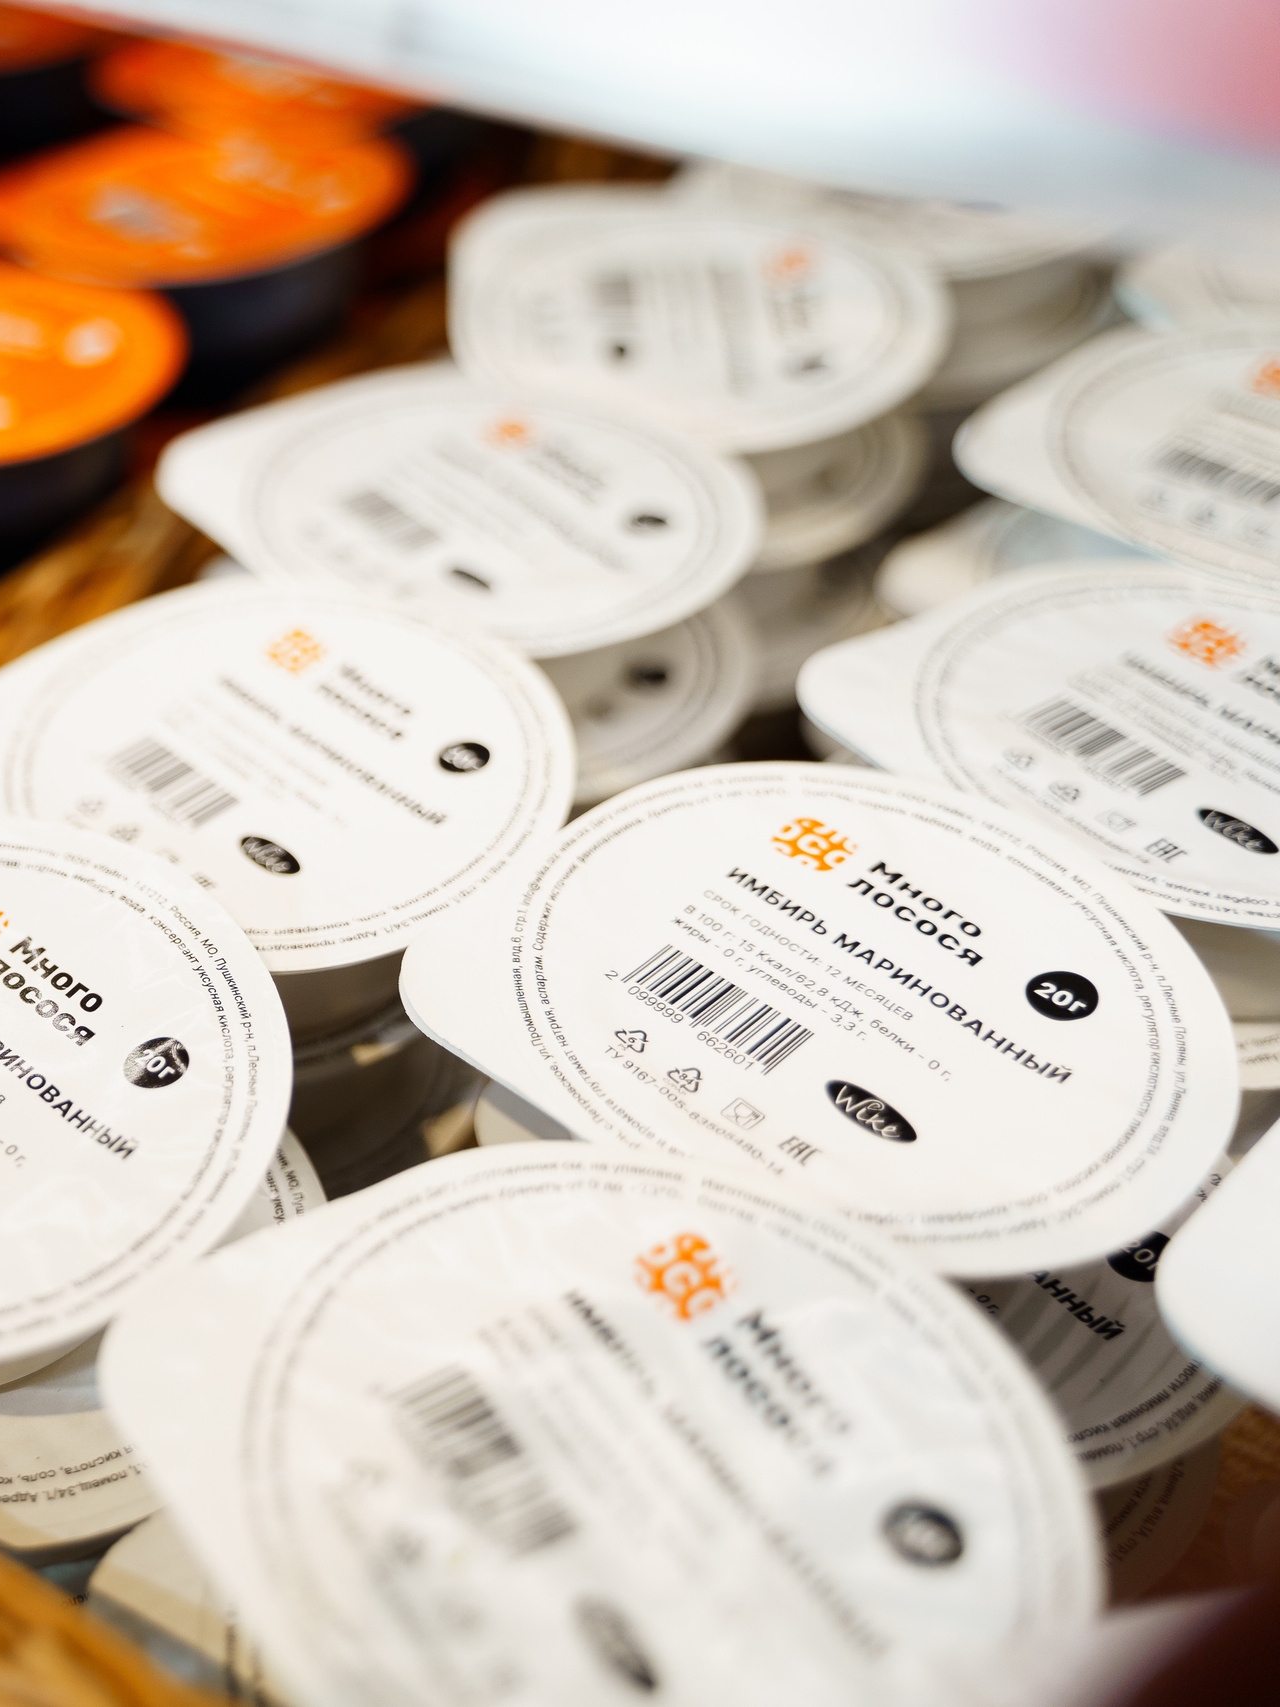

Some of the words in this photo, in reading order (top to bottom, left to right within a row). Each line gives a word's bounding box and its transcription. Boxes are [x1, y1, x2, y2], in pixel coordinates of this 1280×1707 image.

[869, 861, 983, 939] Много
[1072, 899, 1118, 947] уксусная
[532, 902, 553, 951] Содержит
[9, 936, 103, 1013] Много
[169, 905, 202, 940] Россия,
[199, 938, 219, 958] МО,
[214, 957, 252, 1020] Пушкинский
[242, 1018, 255, 1043] р-н,
[532, 954, 550, 1006] аспартам.
[672, 917, 711, 944] жиры
[723, 948, 735, 958] 0
[745, 965, 819, 1009] углеводы
[830, 1013, 856, 1032] 3,3
[856, 1031, 868, 1041] г.
[703, 889, 741, 915] СРОК
[741, 914, 822, 965] ГОДНОСТИ:
[824, 965, 842, 978] 12
[843, 976, 914, 1021] МЕСЯЦЕВ
[727, 867, 827, 936] ИМБИРЬ
[832, 933, 1073, 1084] МАРИНОВАННЫЙ
[148, 914, 200, 964] консервант
[192, 963, 225, 1013] уксусная
[217, 1013, 234, 1063] кислота,
[683, 905, 696, 915] В
[697, 913, 723, 932] 100
[738, 939, 756, 953] 15
[756, 950, 829, 997] Ккал/62,8
[829, 995, 865, 1022] кДж,
[870, 1019, 916, 1053] белки
[928, 1060, 940, 1070] 0
[940, 1070, 952, 1082] г,
[1033, 981, 1087, 1012] 20г
[604, 970, 619, 980] 2
[627, 985, 684, 1024] 099999
[696, 1030, 755, 1071] 662601
[135, 1049, 176, 1079] 20г
[604, 1045, 624, 1060] ТУ
[284, 1169, 300, 1191] МО,
[291, 1192, 306, 1216] Пуш
[1031, 1270, 1126, 1341] АННЫЙ
[1111, 1389, 1171, 1429] лимонная
[17, 1468, 57, 1484] соль,
[59, 1450, 122, 1475] кислота,
